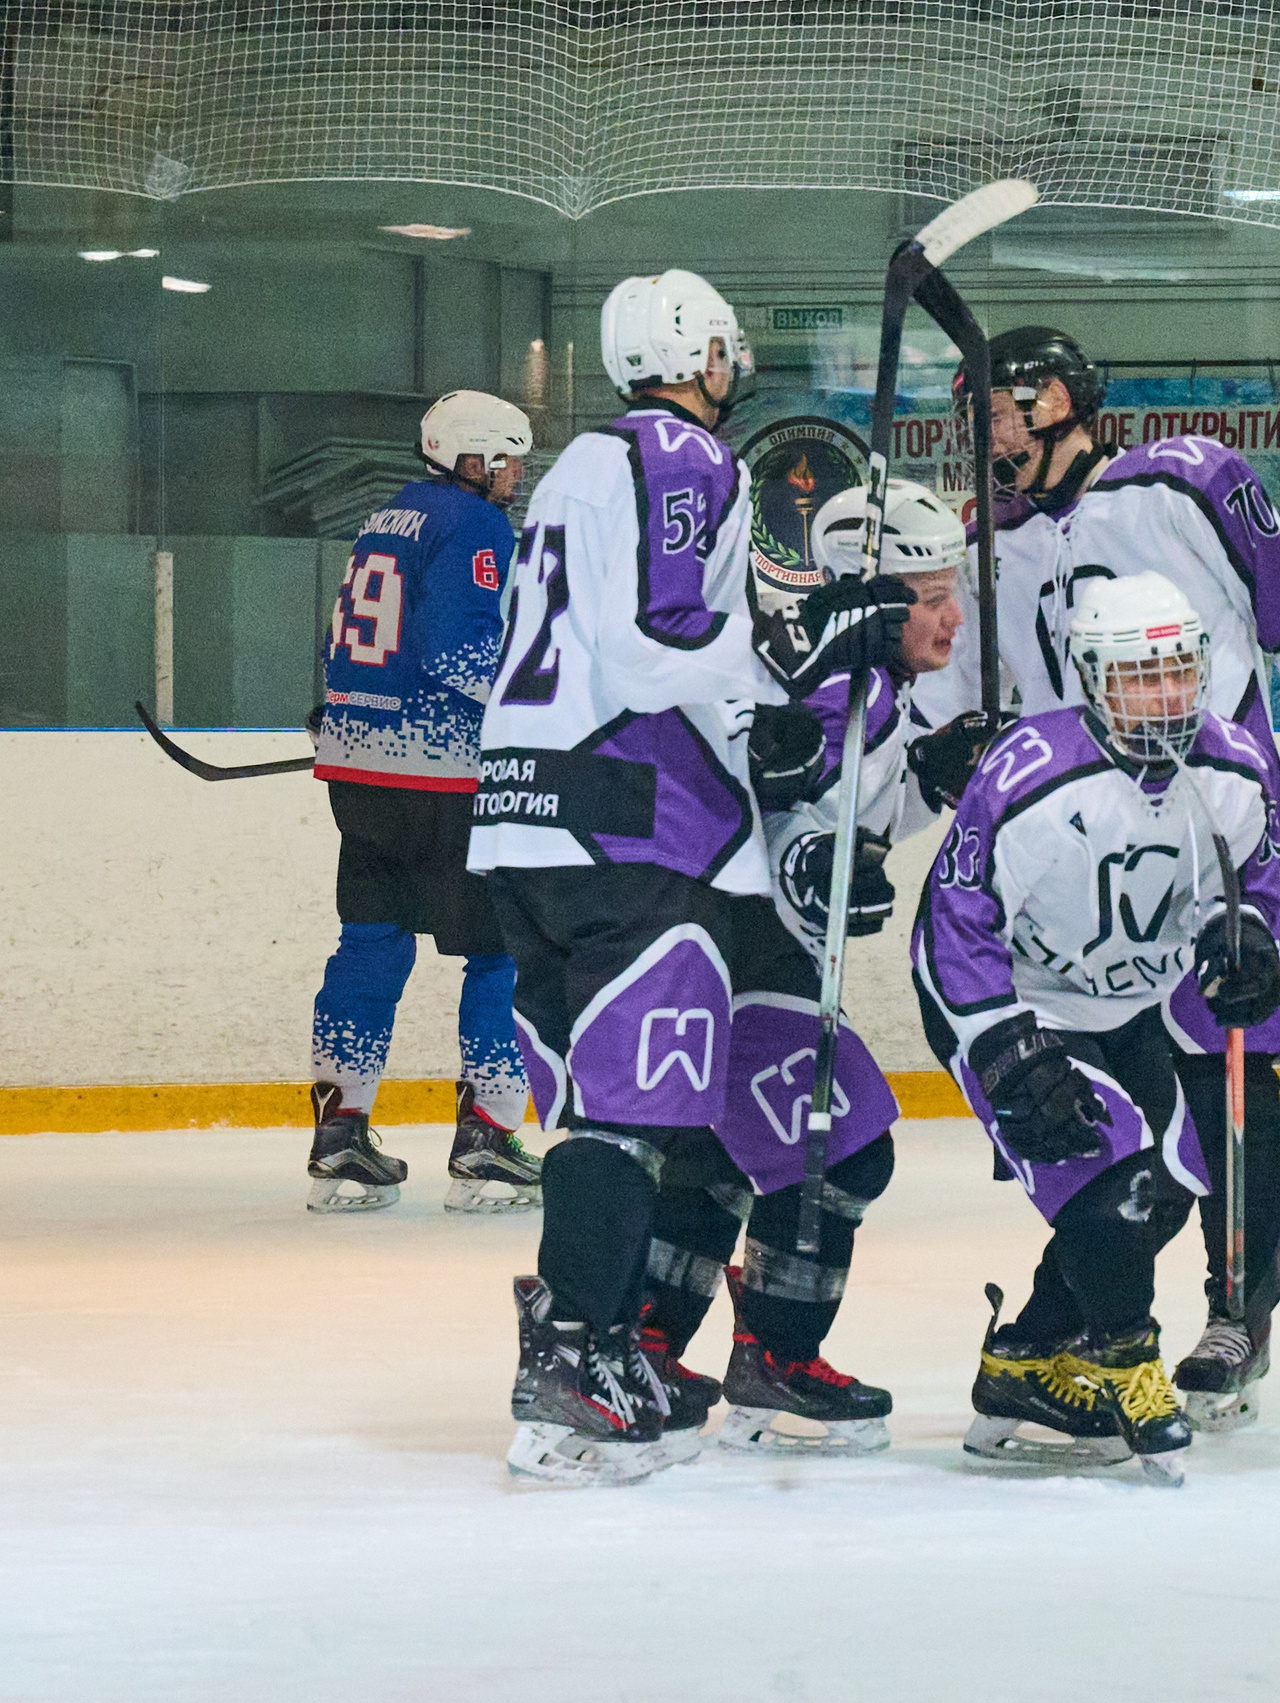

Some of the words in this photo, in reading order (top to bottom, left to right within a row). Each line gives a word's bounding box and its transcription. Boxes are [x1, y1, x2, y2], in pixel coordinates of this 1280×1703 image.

[775, 310, 840, 328] ВЫХОД
[768, 426, 835, 445] ОЛИМПИЯ
[1223, 478, 1280, 549] 70
[472, 548, 499, 591] 6
[754, 550, 822, 584] ПОРТИВНАЯ
